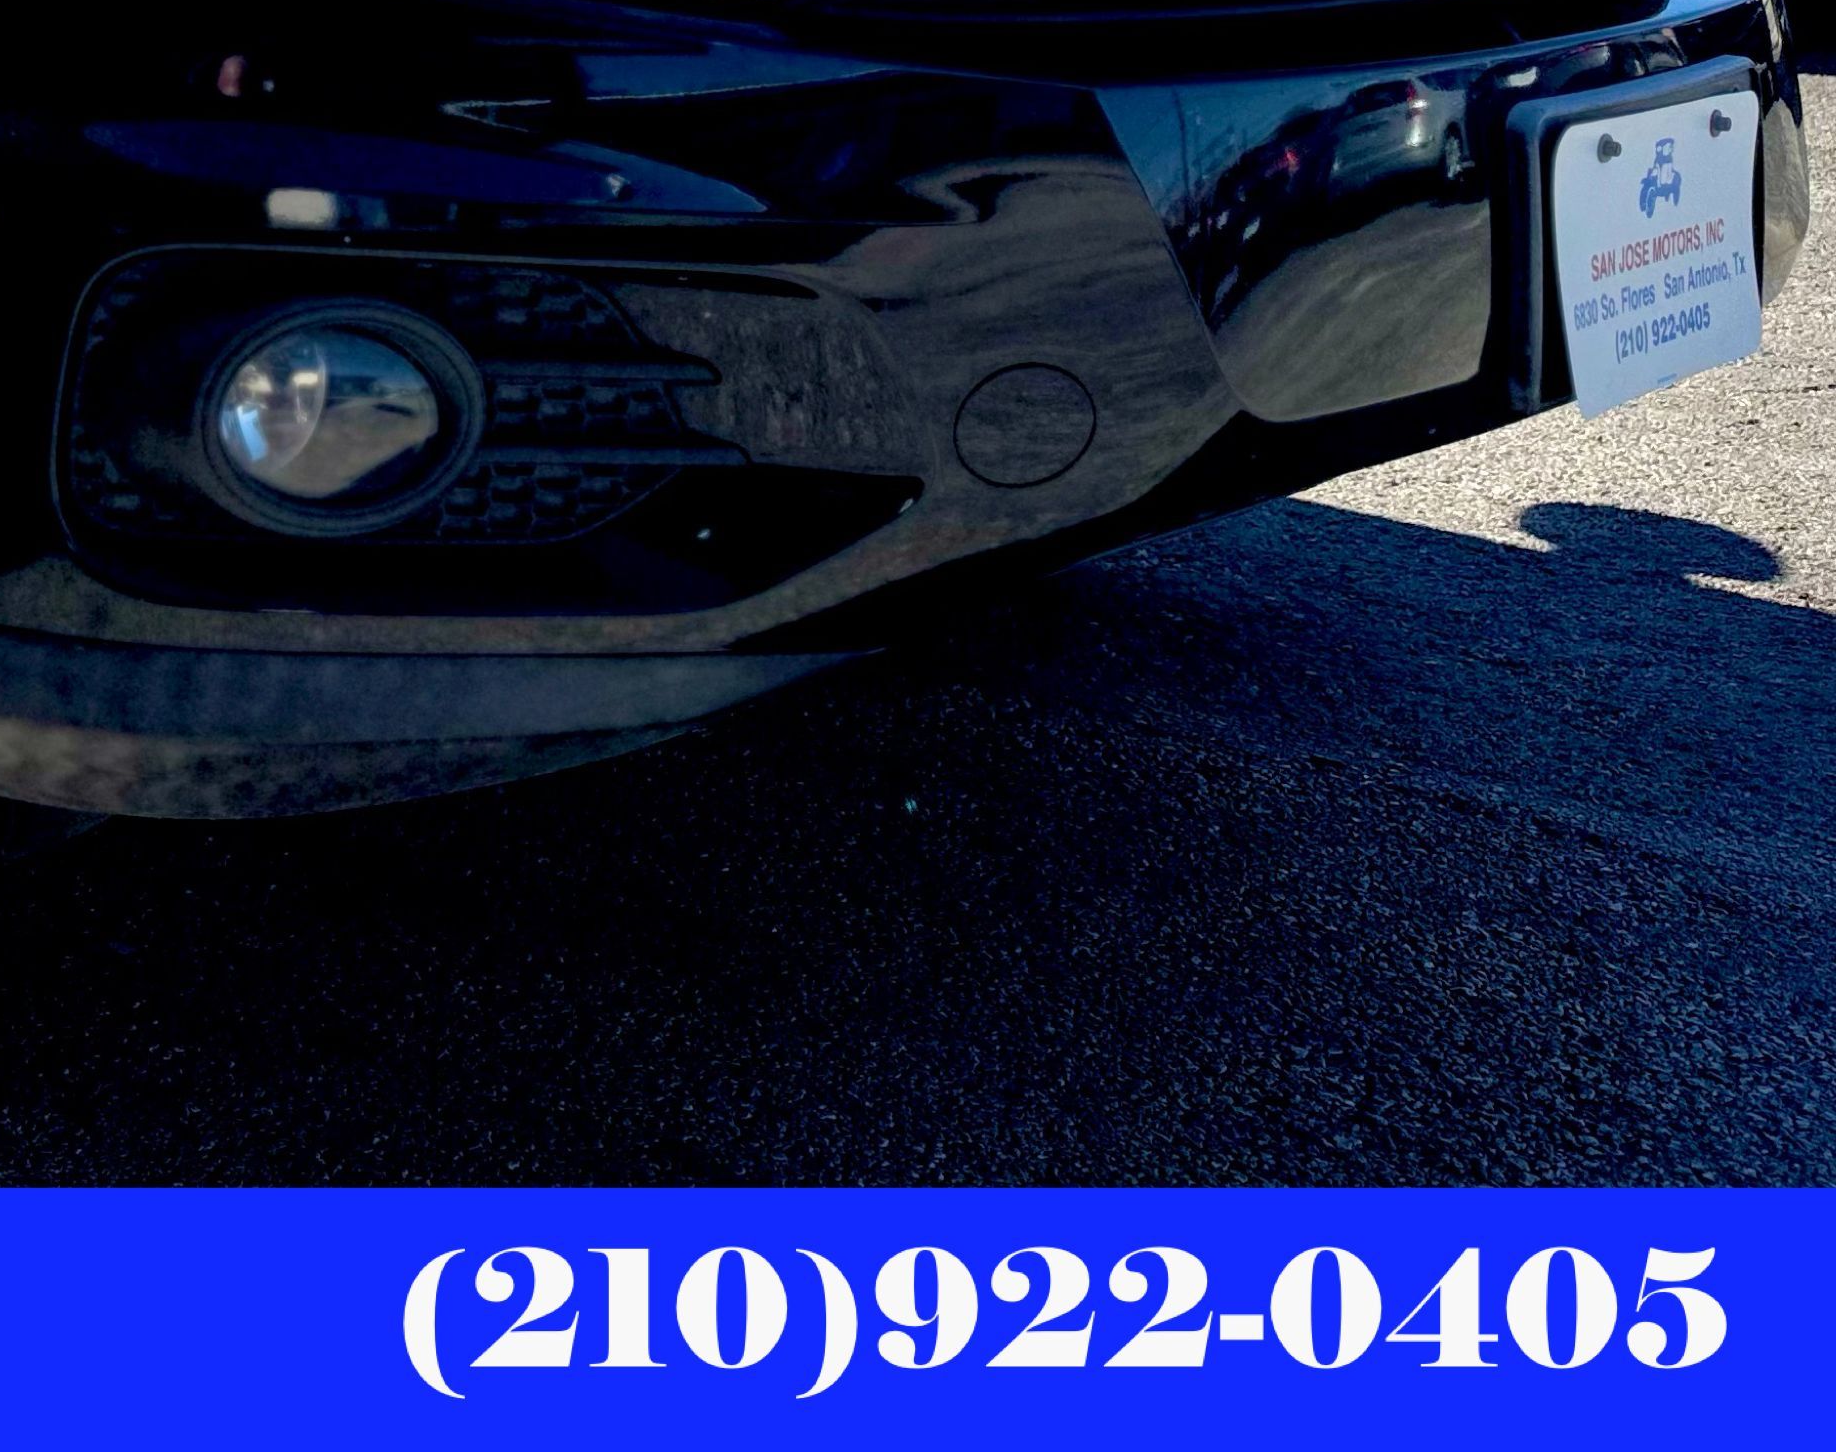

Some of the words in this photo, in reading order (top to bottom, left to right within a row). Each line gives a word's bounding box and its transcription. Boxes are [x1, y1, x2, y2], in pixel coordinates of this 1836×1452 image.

[1591, 249, 1616, 282] SAN
[1619, 240, 1650, 274] JOSE
[1652, 224, 1704, 262] MOTORS,
[1706, 217, 1725, 247] INC
[1574, 298, 1599, 331] 6830
[1601, 293, 1619, 321] So.
[1621, 283, 1656, 314] Flores
[1664, 272, 1685, 299] San
[1687, 260, 1732, 292] Antonio,
[1732, 251, 1747, 276] Tx
[1615, 320, 1649, 364] (210)
[1651, 302, 1711, 347] 922-0405
